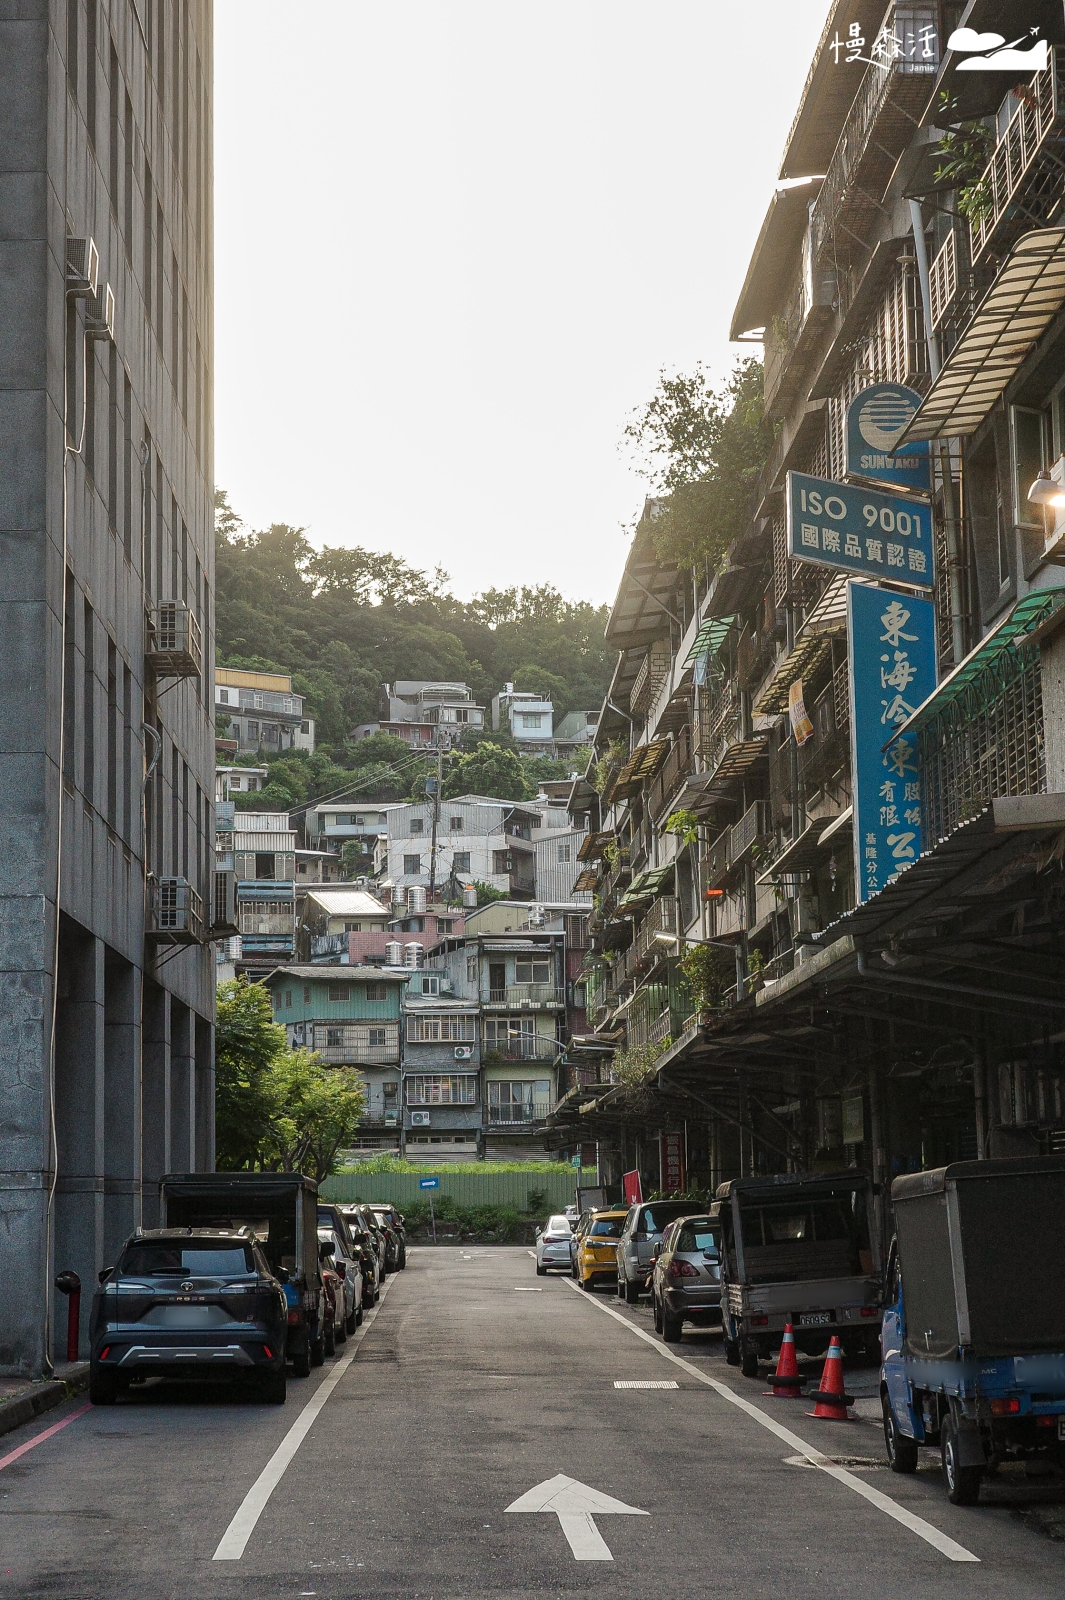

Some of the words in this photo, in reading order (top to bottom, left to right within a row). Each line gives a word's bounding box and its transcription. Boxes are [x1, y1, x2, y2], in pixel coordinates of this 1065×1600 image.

[800, 489, 848, 520] ISO
[862, 504, 922, 539] 9001
[800, 522, 927, 574] 國際品質認證
[878, 780, 901, 827] 有限
